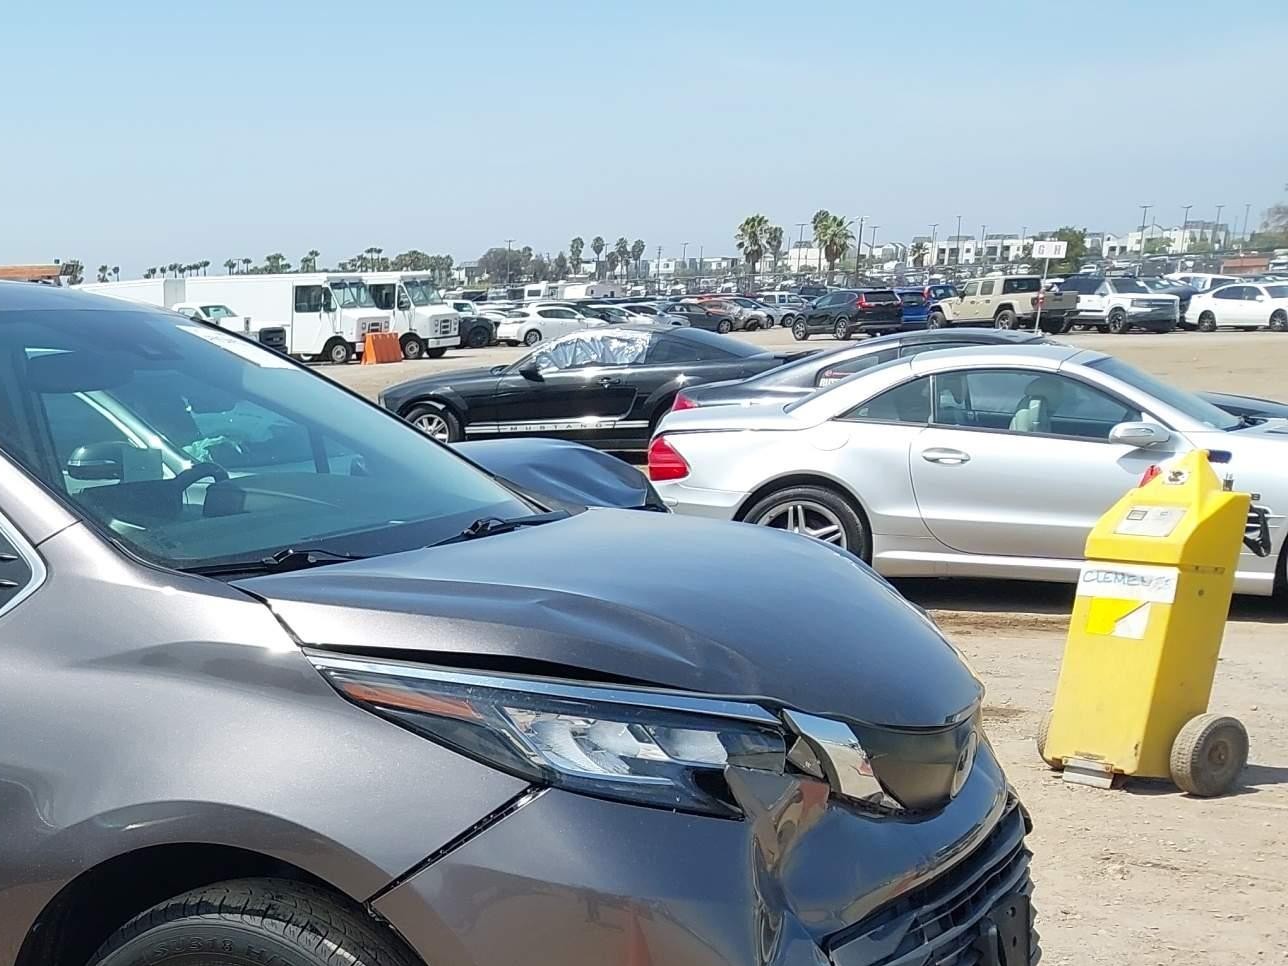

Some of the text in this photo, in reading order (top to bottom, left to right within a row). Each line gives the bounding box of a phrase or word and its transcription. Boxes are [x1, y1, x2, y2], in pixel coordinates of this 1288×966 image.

[1038, 244, 1062, 255] G H
[509, 423, 603, 432] MUSTANG
